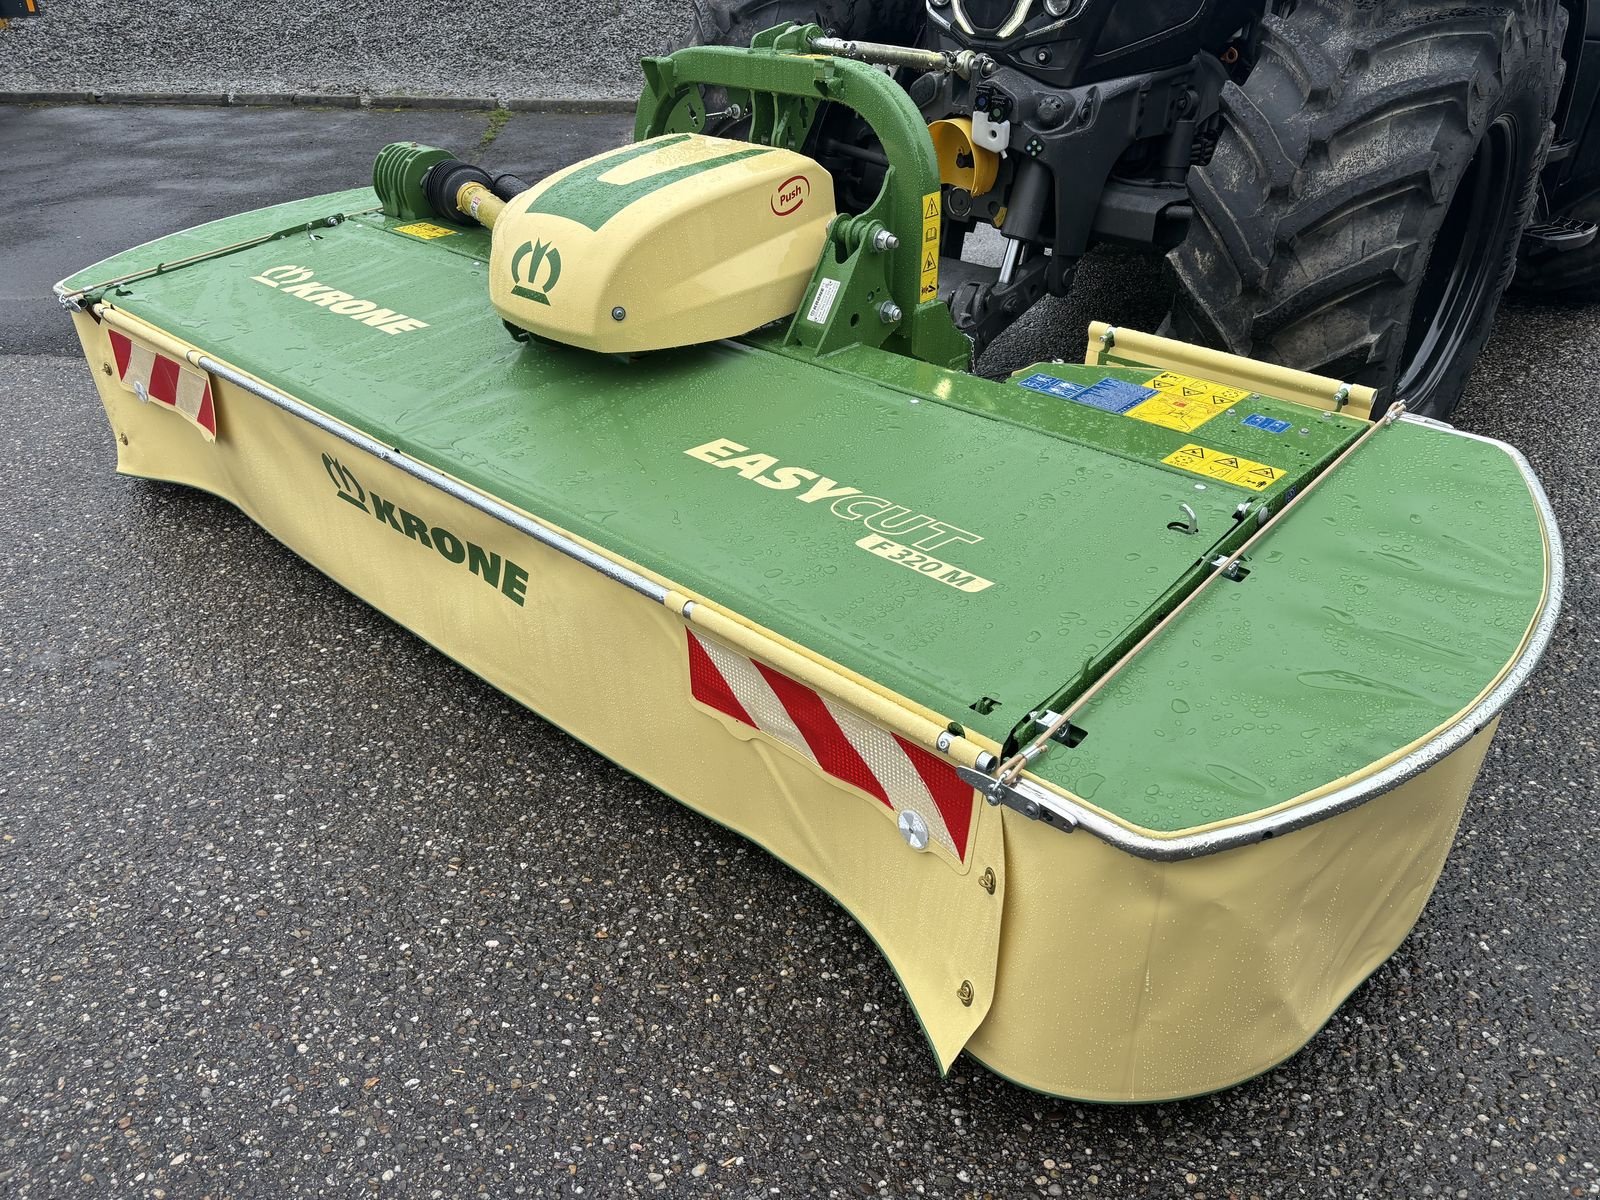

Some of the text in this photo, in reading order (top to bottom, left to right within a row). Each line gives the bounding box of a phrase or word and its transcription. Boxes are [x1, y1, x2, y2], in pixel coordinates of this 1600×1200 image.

[780, 185, 801, 206] Push
[281, 281, 430, 335] KRONE
[368, 491, 530, 607] KRONE
[868, 541, 976, 587] F 320 M
